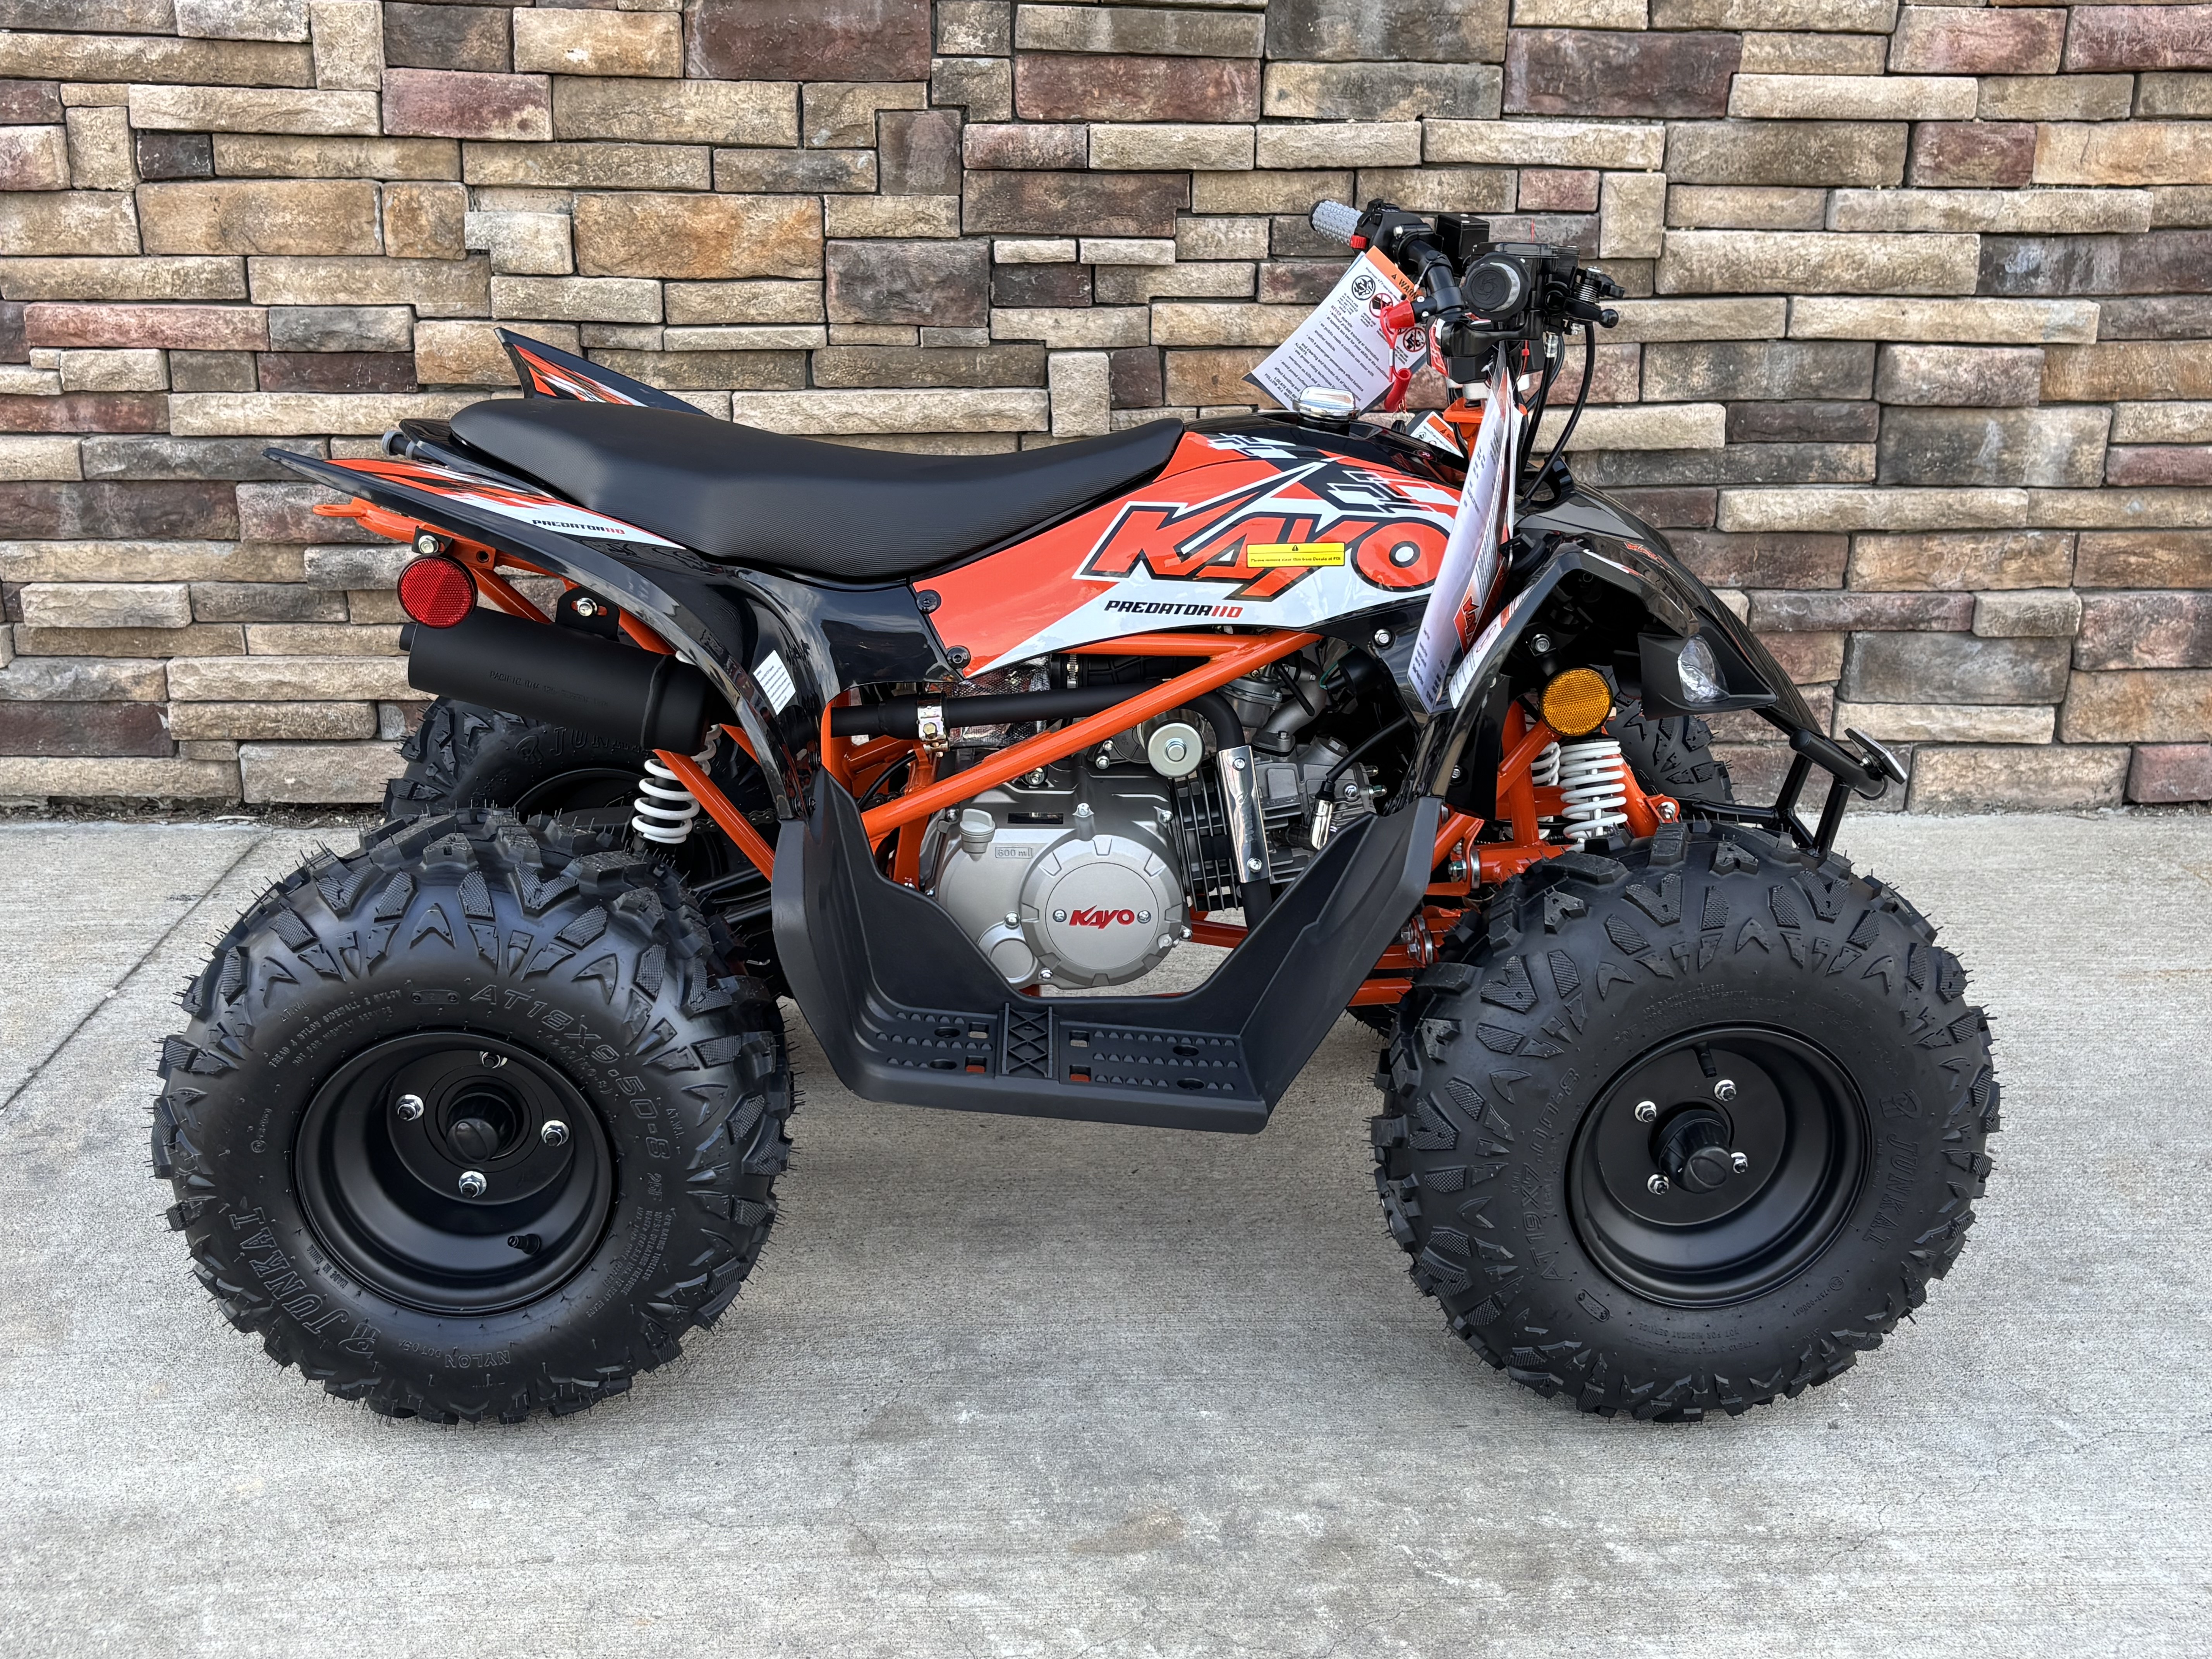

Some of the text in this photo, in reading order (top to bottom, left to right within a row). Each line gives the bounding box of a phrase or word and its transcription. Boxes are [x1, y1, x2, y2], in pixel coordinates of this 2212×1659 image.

[1397, 278, 1419, 299] WARN
[1075, 478, 1450, 601] KAYO
[1069, 904, 1135, 929] KAYO
[268, 1045, 291, 1068] TREAD
[296, 1019, 322, 1041] NYLON
[372, 987, 402, 1004] NYLON
[306, 1038, 323, 1053] FOR
[1864, 1132, 1920, 1250] JUNKAI
[230, 1206, 352, 1336] JUNKAI
[304, 1243, 349, 1289] MADE IN CHINA
[618, 1266, 646, 1296] PRESSURE
[601, 1285, 618, 1301] SEAT
[444, 1349, 512, 1368] NYLON
